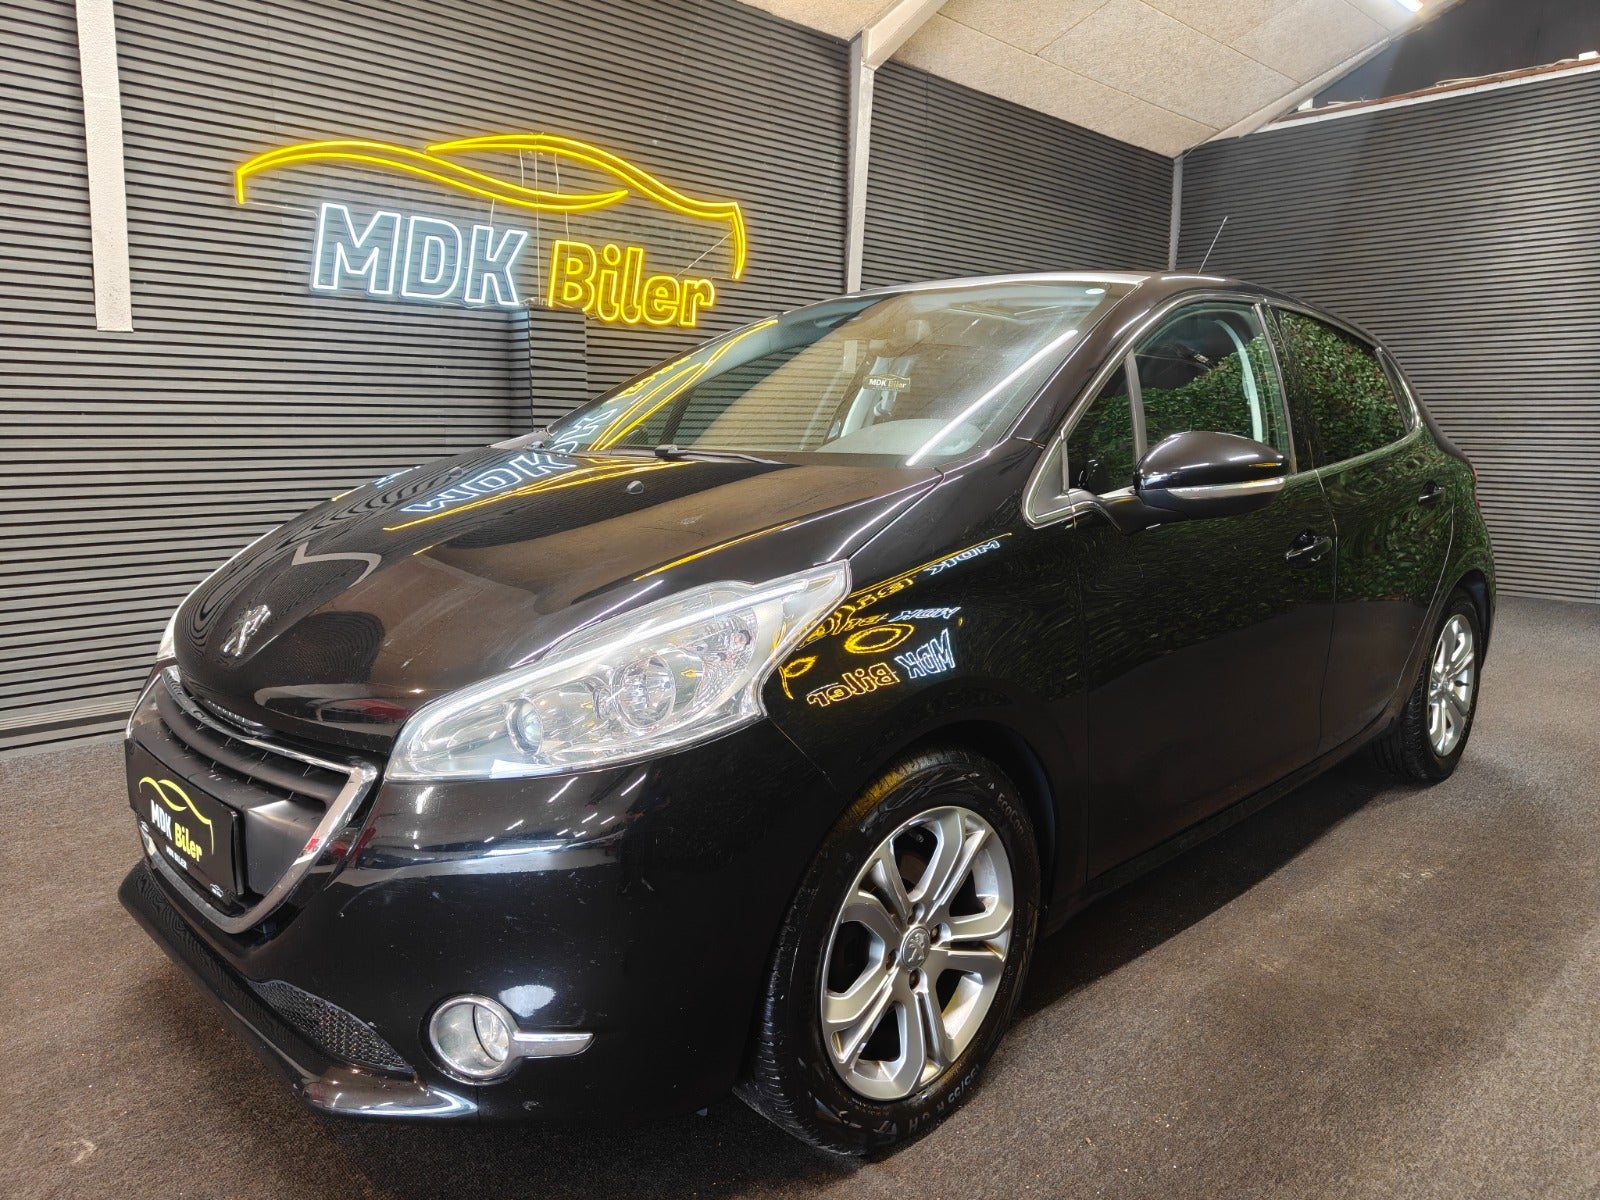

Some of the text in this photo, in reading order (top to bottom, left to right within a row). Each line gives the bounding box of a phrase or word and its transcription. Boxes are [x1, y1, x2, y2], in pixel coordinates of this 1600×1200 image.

[312, 203, 717, 329] MDK Biler
[868, 379, 887, 387] MDK
[150, 798, 203, 863] MDK Biler
